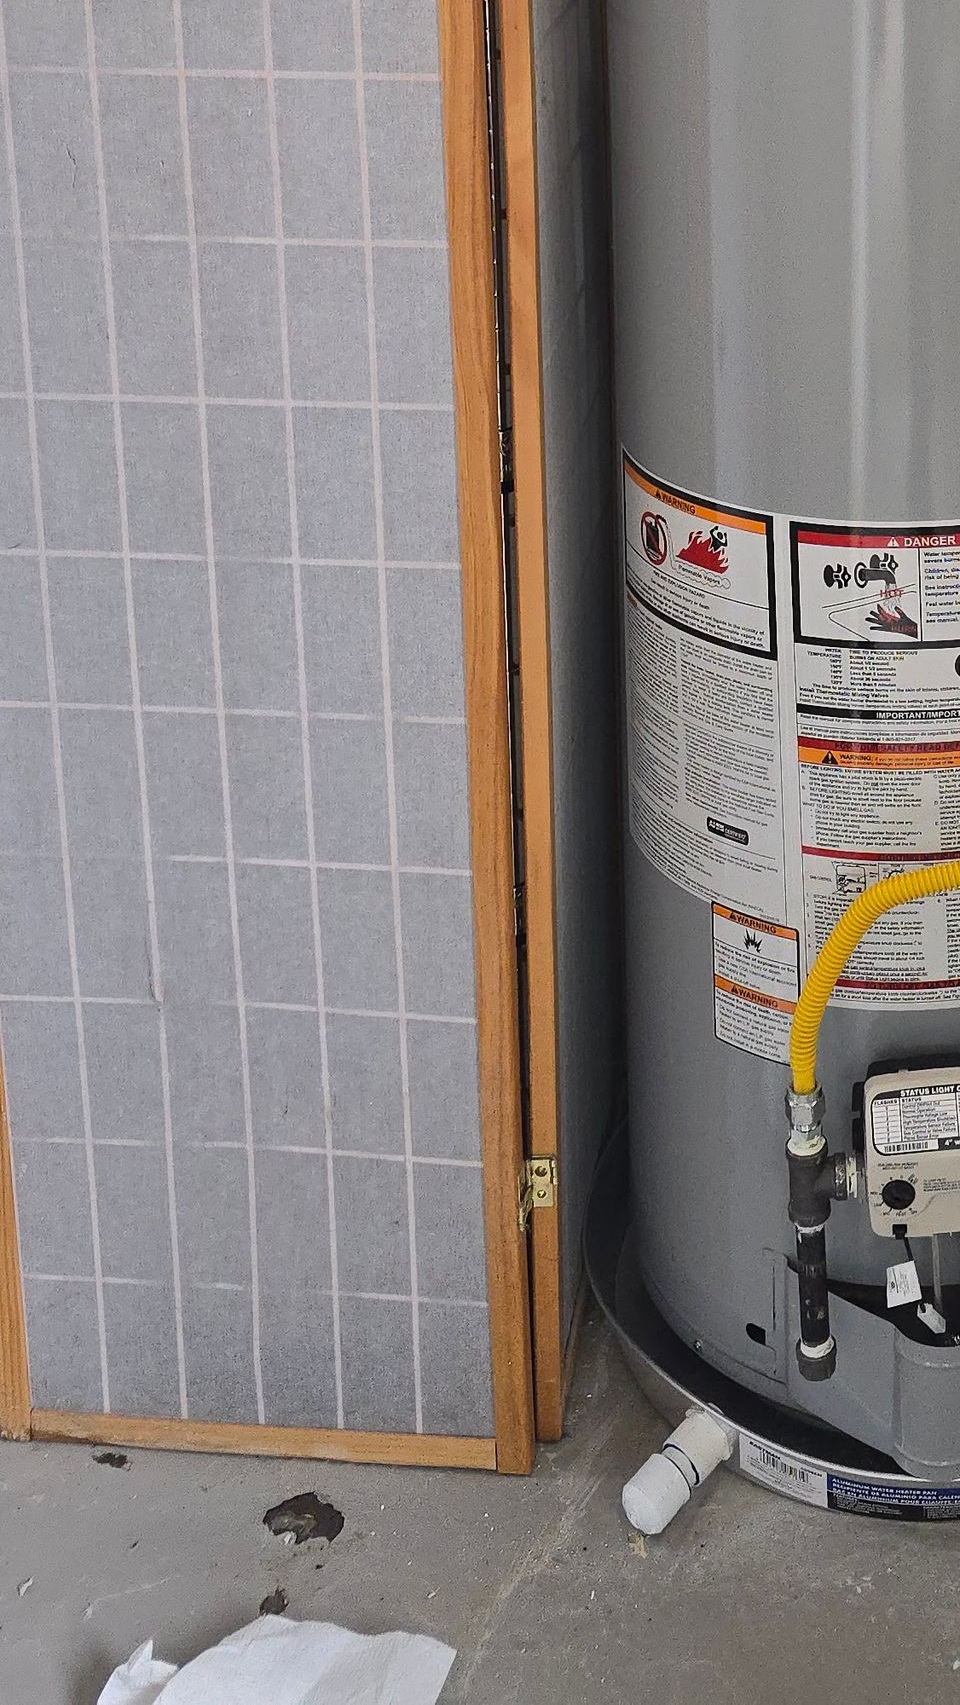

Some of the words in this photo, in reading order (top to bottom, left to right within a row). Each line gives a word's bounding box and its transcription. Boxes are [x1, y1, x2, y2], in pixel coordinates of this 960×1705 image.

[663, 494, 696, 515] WARNING
[904, 535, 956, 547] DANGER
[880, 589, 904, 597] HOT
[735, 915, 777, 934] WARNING
[737, 987, 779, 1008] WARNING
[931, 1086, 954, 1094] LIGHT
[832, 1477, 870, 1489] ALUMINUM
